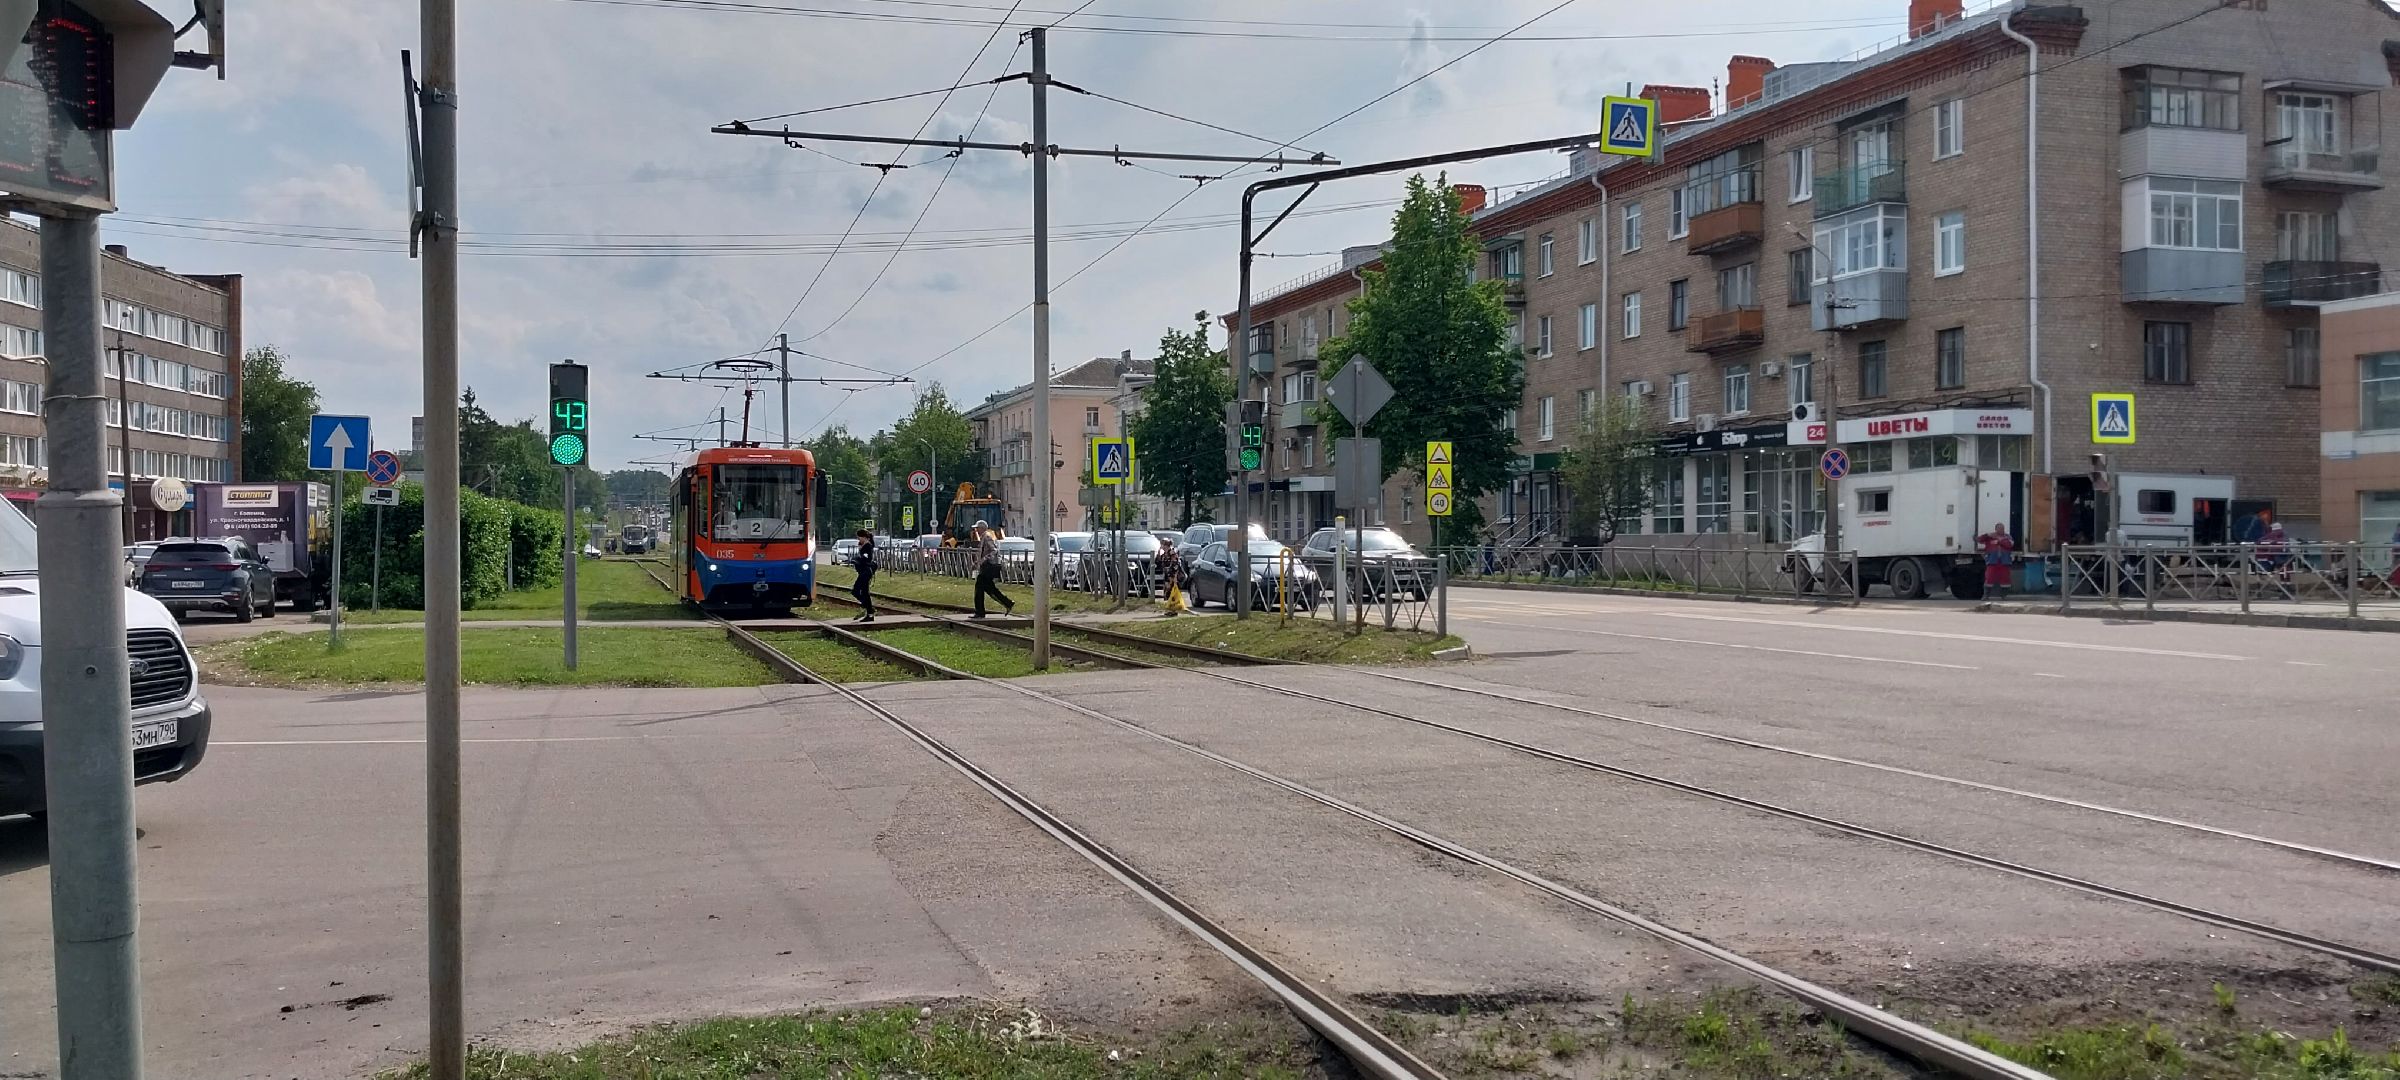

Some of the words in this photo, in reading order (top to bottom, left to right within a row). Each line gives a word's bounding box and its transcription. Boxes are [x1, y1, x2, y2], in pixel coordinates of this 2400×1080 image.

[556, 402, 585, 430] 43
[1868, 417, 1928, 436] ЦВЕТЫ
[1243, 427, 1261, 446] 43
[1808, 427, 1824, 438] 24
[913, 477, 926, 486] 40
[1434, 499, 1445, 507] 40
[752, 522, 761, 533] 2
[716, 549, 735, 558] 035
